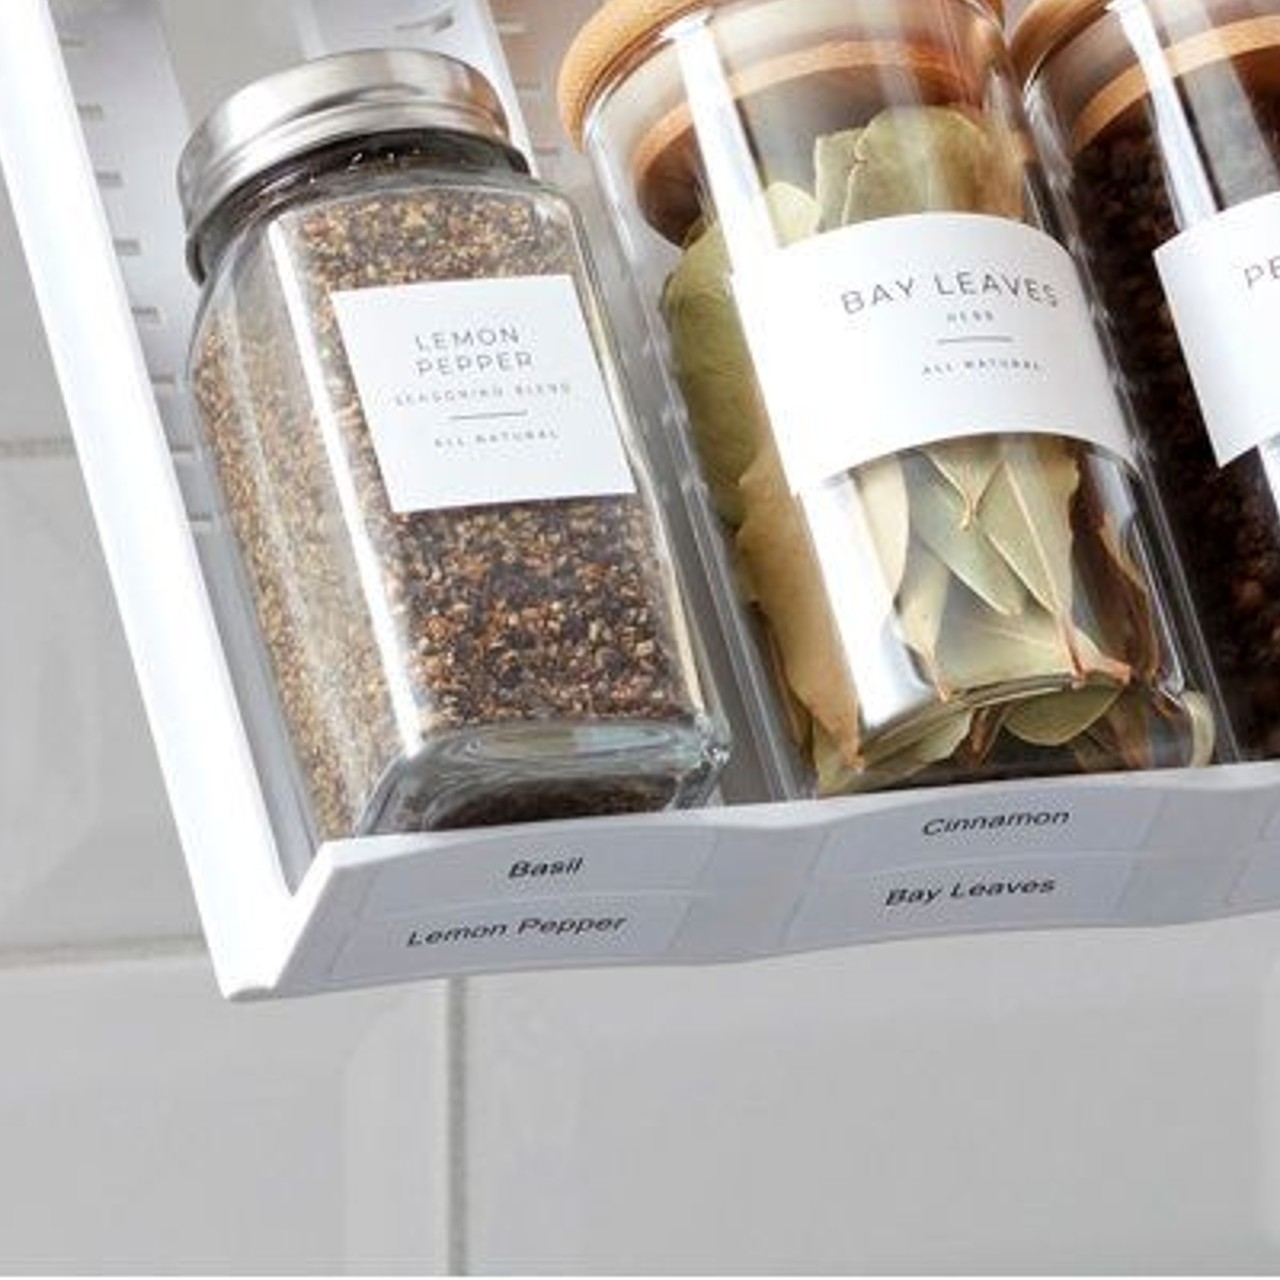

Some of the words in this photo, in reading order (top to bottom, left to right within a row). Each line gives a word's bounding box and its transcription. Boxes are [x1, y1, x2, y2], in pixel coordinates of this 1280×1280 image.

[840, 276, 915, 316] BAY
[933, 270, 1059, 309] LEAVES
[414, 327, 521, 353] LEMON
[415, 351, 533, 377] PEPPER
[921, 808, 1071, 838] Cinnamon
[507, 855, 584, 881] Basil
[884, 886, 943, 909] Bay
[949, 878, 1056, 900] Leaves
[405, 921, 509, 949] Lemon
[516, 914, 629, 938] Pepper
